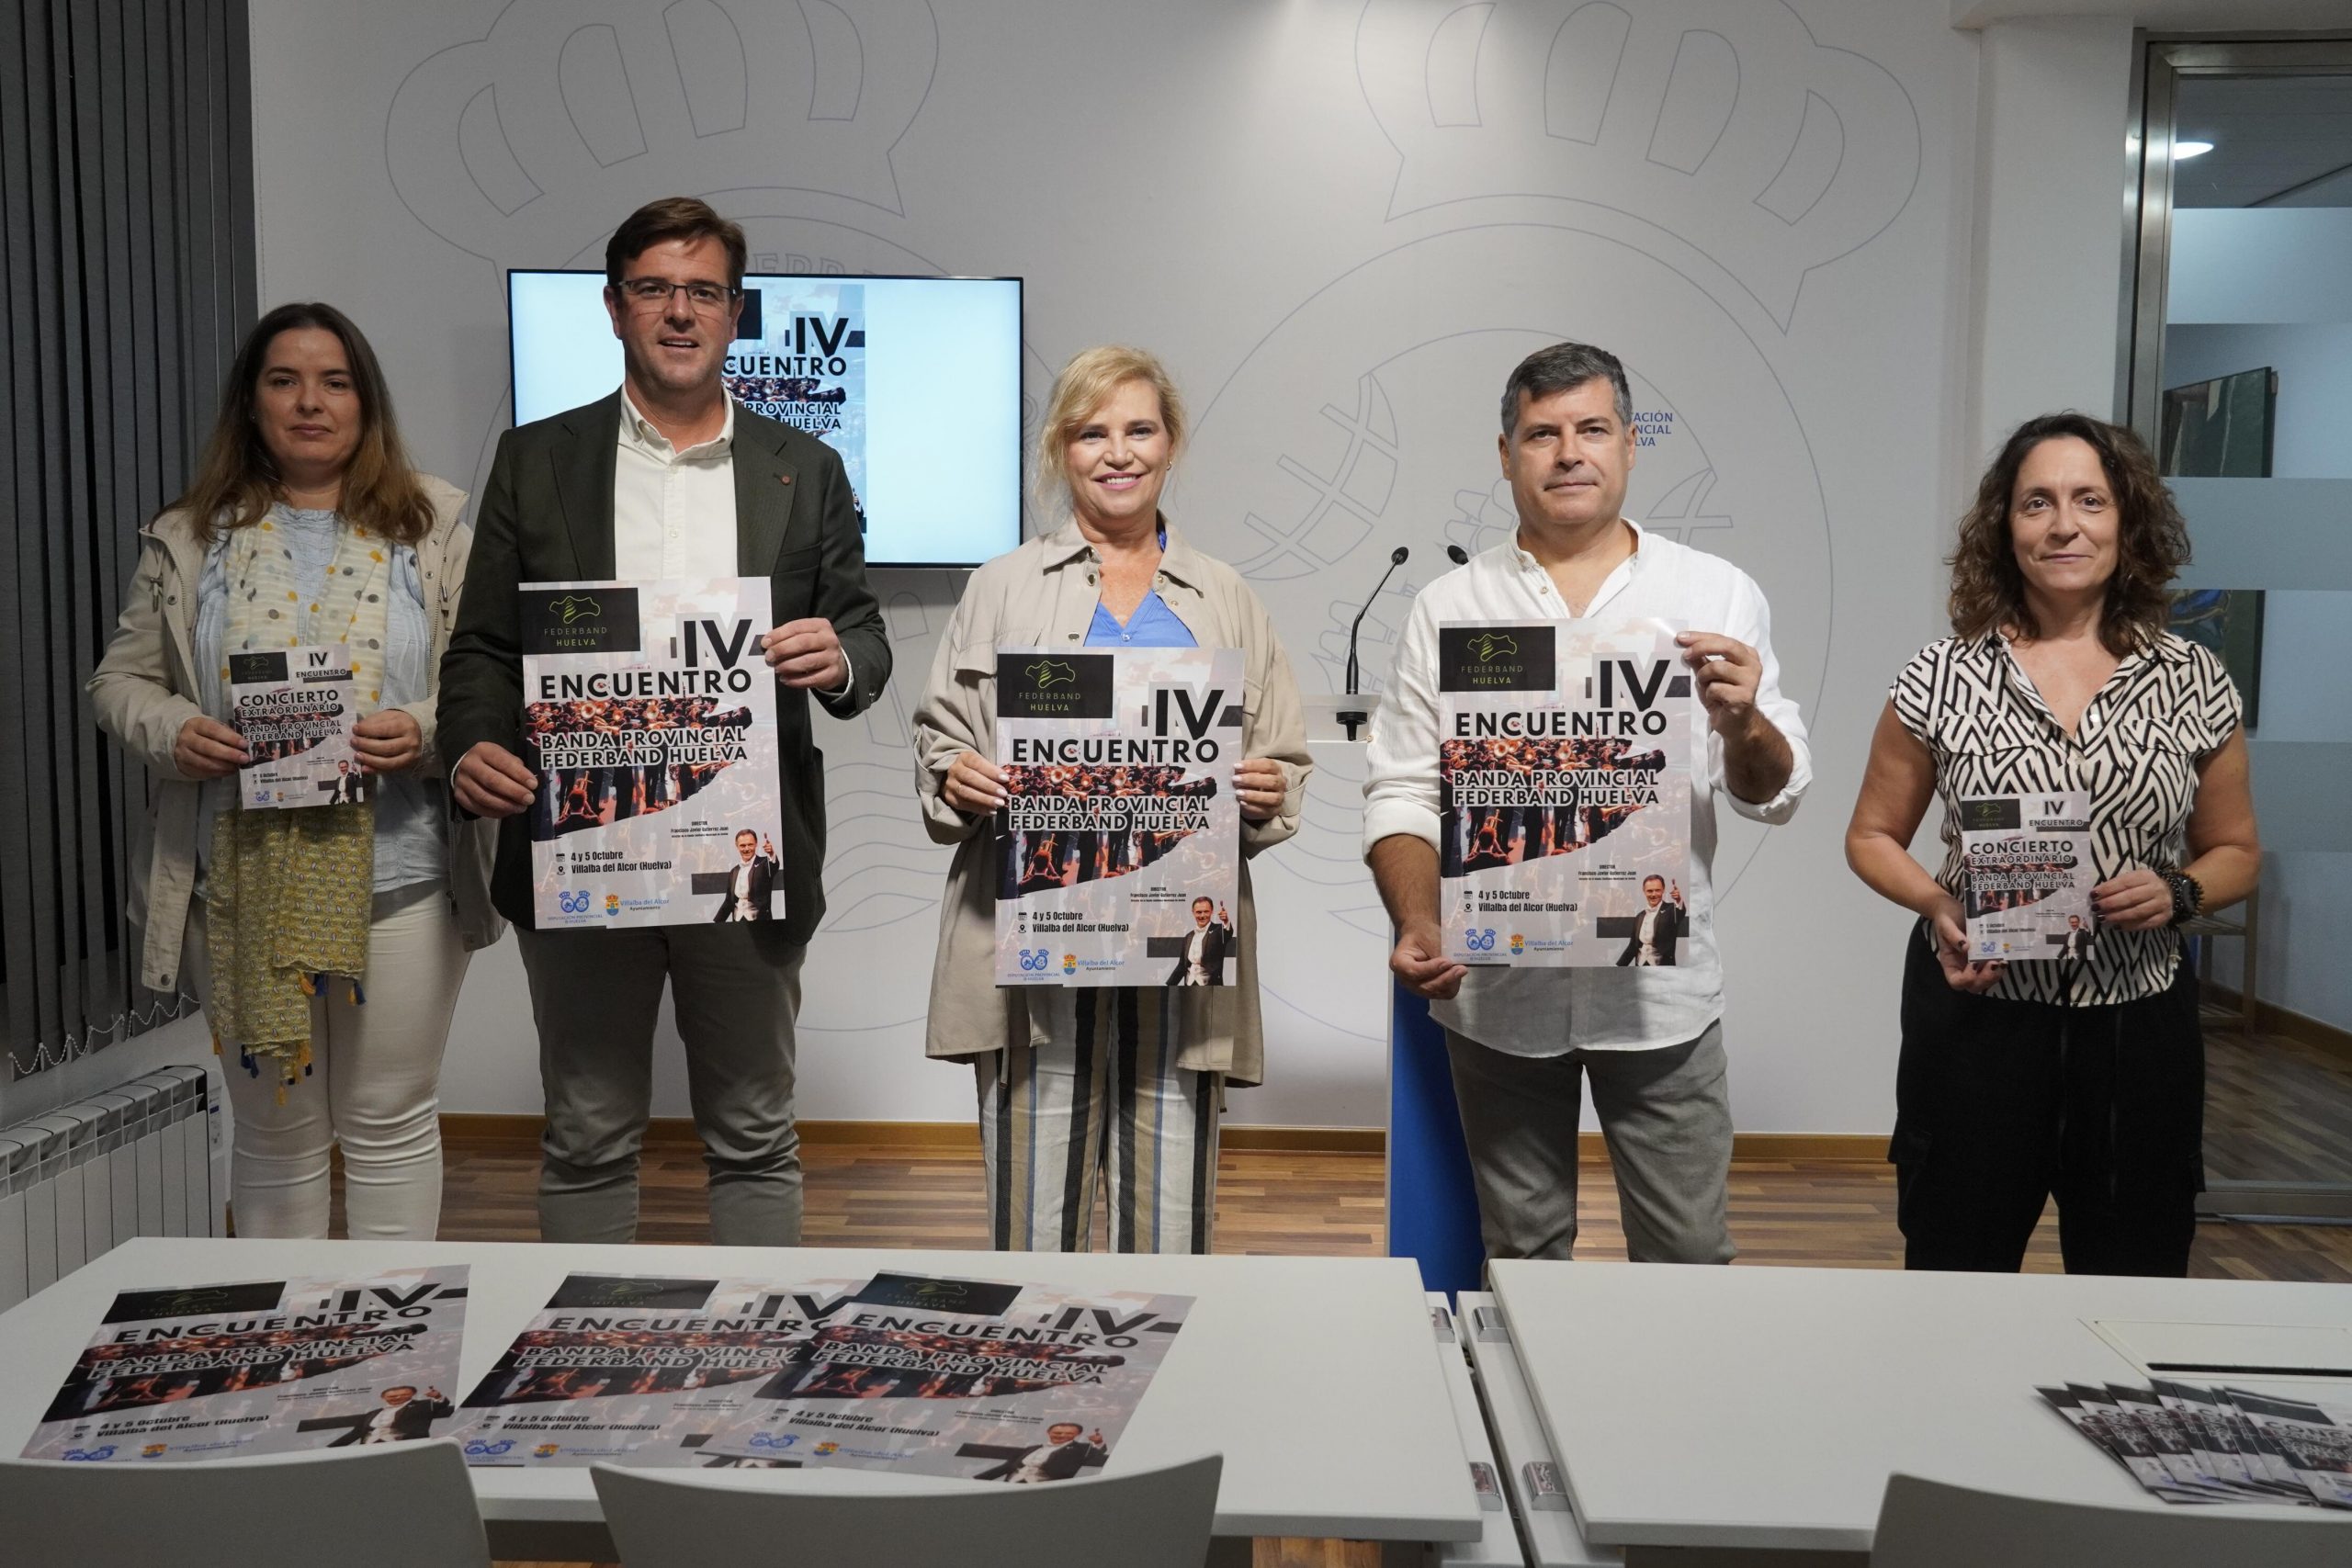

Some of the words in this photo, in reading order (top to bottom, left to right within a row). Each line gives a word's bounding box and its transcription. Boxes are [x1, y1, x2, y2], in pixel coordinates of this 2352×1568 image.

[796, 317, 849, 357] IV
[723, 355, 847, 377] CUENTRO
[745, 402, 842, 414] PROVINCIAL
[1632, 410, 1673, 423] ACIÓN
[545, 626, 607, 636] FEDERBAND
[556, 638, 596, 647] HUELVA
[684, 619, 752, 671] IV
[309, 652, 328, 667] IV
[296, 669, 346, 678] ENCUENTRO
[1461, 665, 1523, 673] FEDERBAND
[540, 669, 752, 699] ENCUENTRO
[1473, 676, 1511, 684] HUELVA
[1600, 660, 1670, 712] IV
[240, 690, 338, 707] CONCIERTO
[1019, 692, 1081, 700] FEDERBAND
[242, 703, 337, 717] EXTRAORDINARIO
[1156, 689, 1225, 740] IV
[243, 724, 277, 734] BANDA
[281, 720, 342, 730] PROVINCIAL
[1455, 710, 1667, 736] ENCUENTRO
[243, 731, 300, 742] FEDERBAND
[305, 728, 343, 737] HUELVA
[542, 732, 614, 750] BANDA
[621, 728, 746, 746] PROVINCIAL
[543, 750, 662, 768] FEDERBAND
[670, 746, 748, 762] HUELVA
[1012, 739, 1219, 763] ENCUENTRO
[1454, 772, 1527, 786] BANDA
[1532, 771, 1658, 786] PROVINCIAL
[1011, 796, 1081, 812] BANDA
[1089, 796, 1210, 812] PROVINCIAL
[1454, 790, 1571, 805] FEDERBAND
[1580, 789, 1658, 804] HUELVA
[2044, 801, 2064, 815] IV
[1011, 815, 1126, 829] FEDERBAND
[1134, 815, 1210, 829] HUELVA
[1970, 840, 2073, 854] CONCIERTO
[571, 852, 576, 862] 4
[578, 853, 583, 863] y
[585, 852, 590, 861] 5
[592, 851, 624, 861] Octubre
[1972, 854, 2072, 864] EXTRAORDINARIO
[571, 863, 601, 874] Villalba
[603, 863, 615, 873] del
[617, 862, 637, 872] Alcor
[639, 861, 672, 871] (Huelva)
[1972, 874, 2007, 882] BANDA
[2010, 872, 2075, 881] PROVINCIAL
[1972, 882, 2030, 891] FEDERBAND
[1478, 891, 1484, 899] 4
[1485, 892, 1490, 901] y
[1492, 891, 1498, 899] 5
[1499, 890, 1530, 899] Octubre
[1478, 903, 1507, 912] Villalba
[1509, 903, 1521, 912] del
[1523, 903, 1544, 912] Alcor
[1545, 902, 1577, 912] (Huelva)
[1033, 912, 1037, 920] 4
[1039, 913, 1045, 921] y
[1046, 912, 1051, 920] 5
[1053, 911, 1083, 920] Octubre
[1033, 923, 1060, 932] Villalba
[1062, 923, 1074, 932] del
[1076, 923, 1095, 932] Alcor
[1098, 922, 1129, 932] (Huelva)
[338, 1283, 442, 1311] IV
[757, 1294, 853, 1320] IV
[114, 1305, 433, 1343] ENCUENTRO
[1056, 1307, 1159, 1336] IV
[851, 1314, 1138, 1348] ENCUENTRO
[97, 1351, 207, 1369] BANDA
[220, 1333, 417, 1359] PROVINCIAL
[526, 1346, 626, 1357] BANDA
[826, 1342, 920, 1358] BANDA
[932, 1352, 1107, 1373] PROVINCIAL
[93, 1354, 280, 1379] FEDERBAND
[290, 1342, 413, 1360] HUELVA
[515, 1356, 691, 1368] FEDERBAND
[814, 1352, 983, 1374] FEDERBAND
[990, 1367, 1102, 1384] HUELVA
[100, 1421, 110, 1429] 4
[124, 1419, 134, 1427] 5
[137, 1416, 190, 1427] Octubre
[788, 1416, 831, 1427] Villalba
[833, 1421, 854, 1429] del
[855, 1423, 888, 1433] Alcor
[826, 1413, 875, 1424] Octubre
[96, 1427, 146, 1438] Villalba
[151, 1424, 172, 1434] del
[175, 1421, 209, 1431] Alcor
